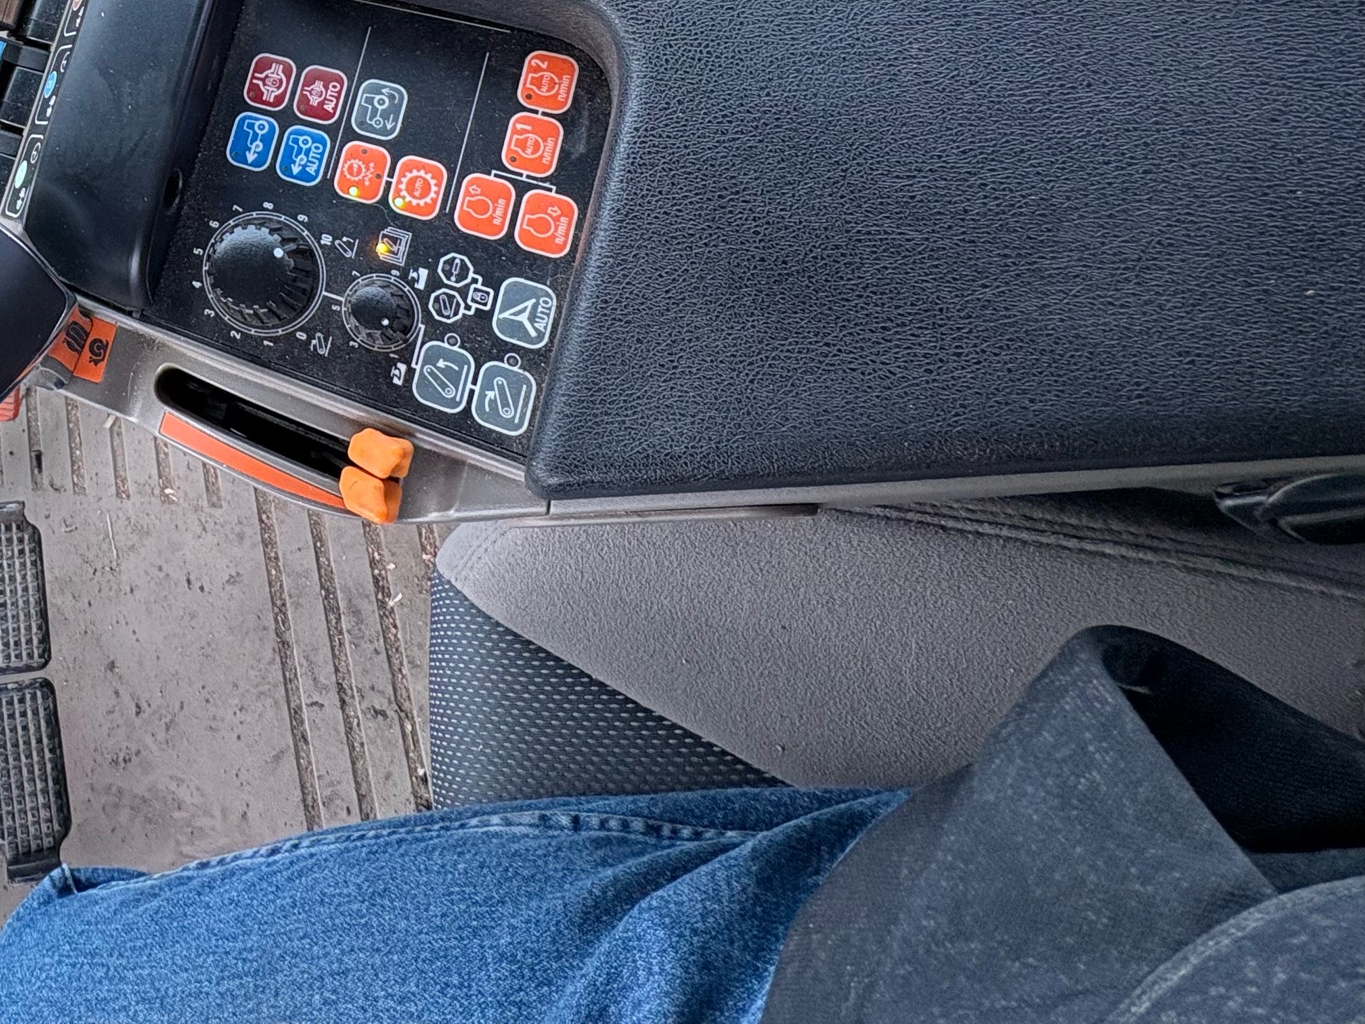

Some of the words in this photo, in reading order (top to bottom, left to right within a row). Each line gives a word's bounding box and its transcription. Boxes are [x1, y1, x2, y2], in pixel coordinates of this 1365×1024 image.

[531, 58, 548, 70] 2
[540, 74, 551, 93] AUTO
[557, 74, 571, 102] n/min
[323, 82, 340, 113] AUTO
[515, 122, 533, 132] 1
[525, 136, 535, 156] AUTO
[541, 137, 556, 165] n/min
[305, 143, 323, 175] AUTO
[413, 178, 424, 197] AUTO
[232, 204, 243, 213] 7
[262, 201, 274, 210] 8
[492, 198, 507, 226] n/min
[209, 220, 220, 228] 6
[296, 214, 309, 223] 9
[554, 216, 569, 245] n/min
[320, 233, 333, 246] 10
[193, 248, 204, 256] 5
[191, 280, 202, 289] 4
[204, 309, 216, 318] 3
[534, 297, 553, 333] AUTO
[230, 330, 241, 340] 2
[296, 331, 307, 340] 0
[349, 340, 359, 349] 3
